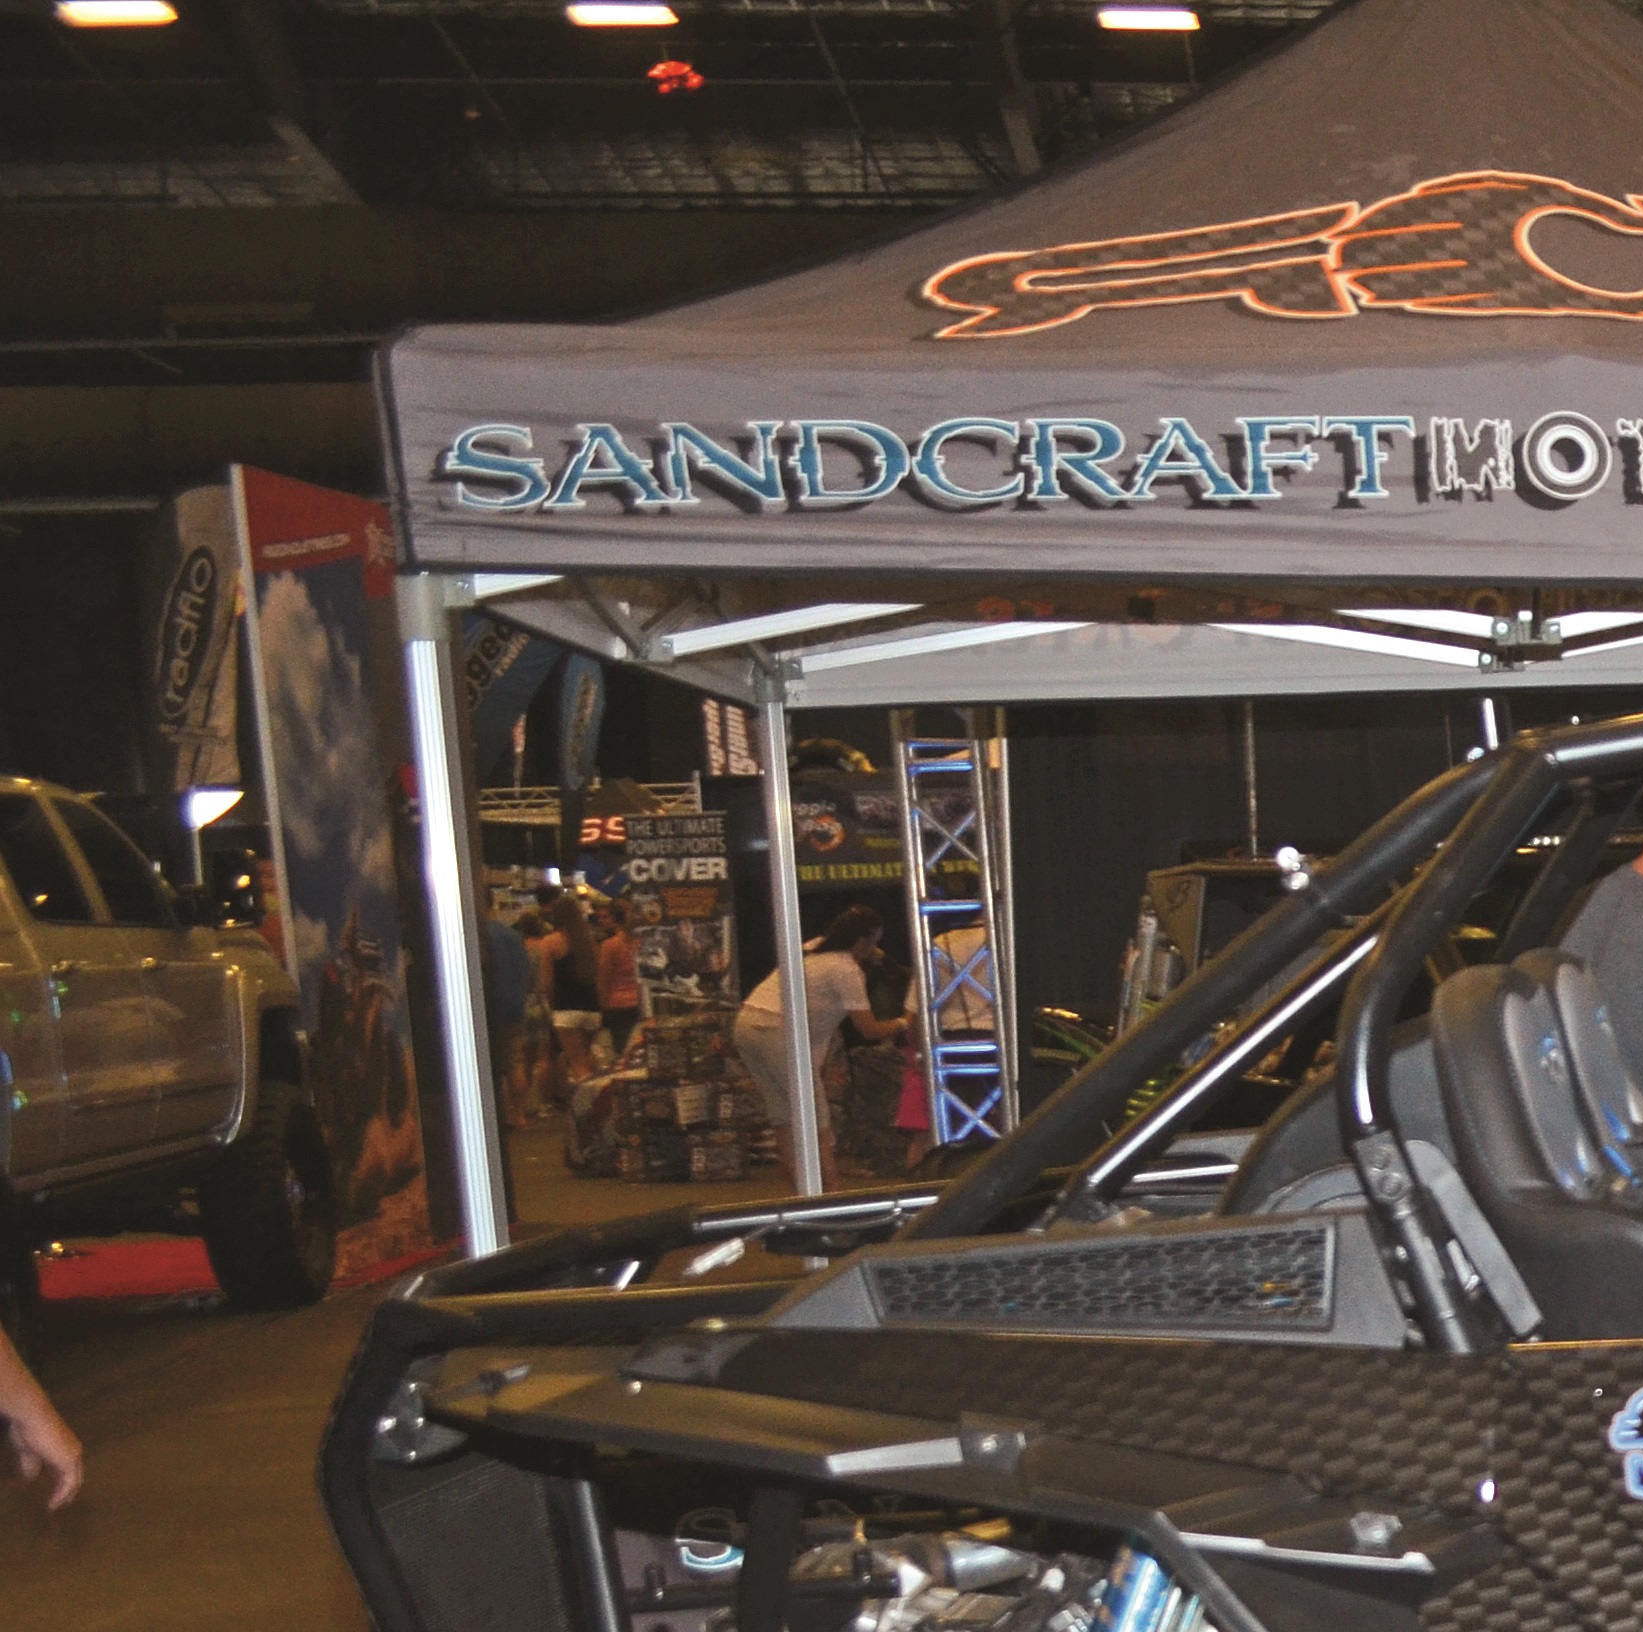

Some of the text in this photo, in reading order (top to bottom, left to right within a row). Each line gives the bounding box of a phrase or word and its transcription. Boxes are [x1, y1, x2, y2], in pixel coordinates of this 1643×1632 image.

[656, 817, 726, 836] ULTIMATE
[626, 836, 727, 855] POWERSPORTS
[629, 857, 730, 882] COVER
